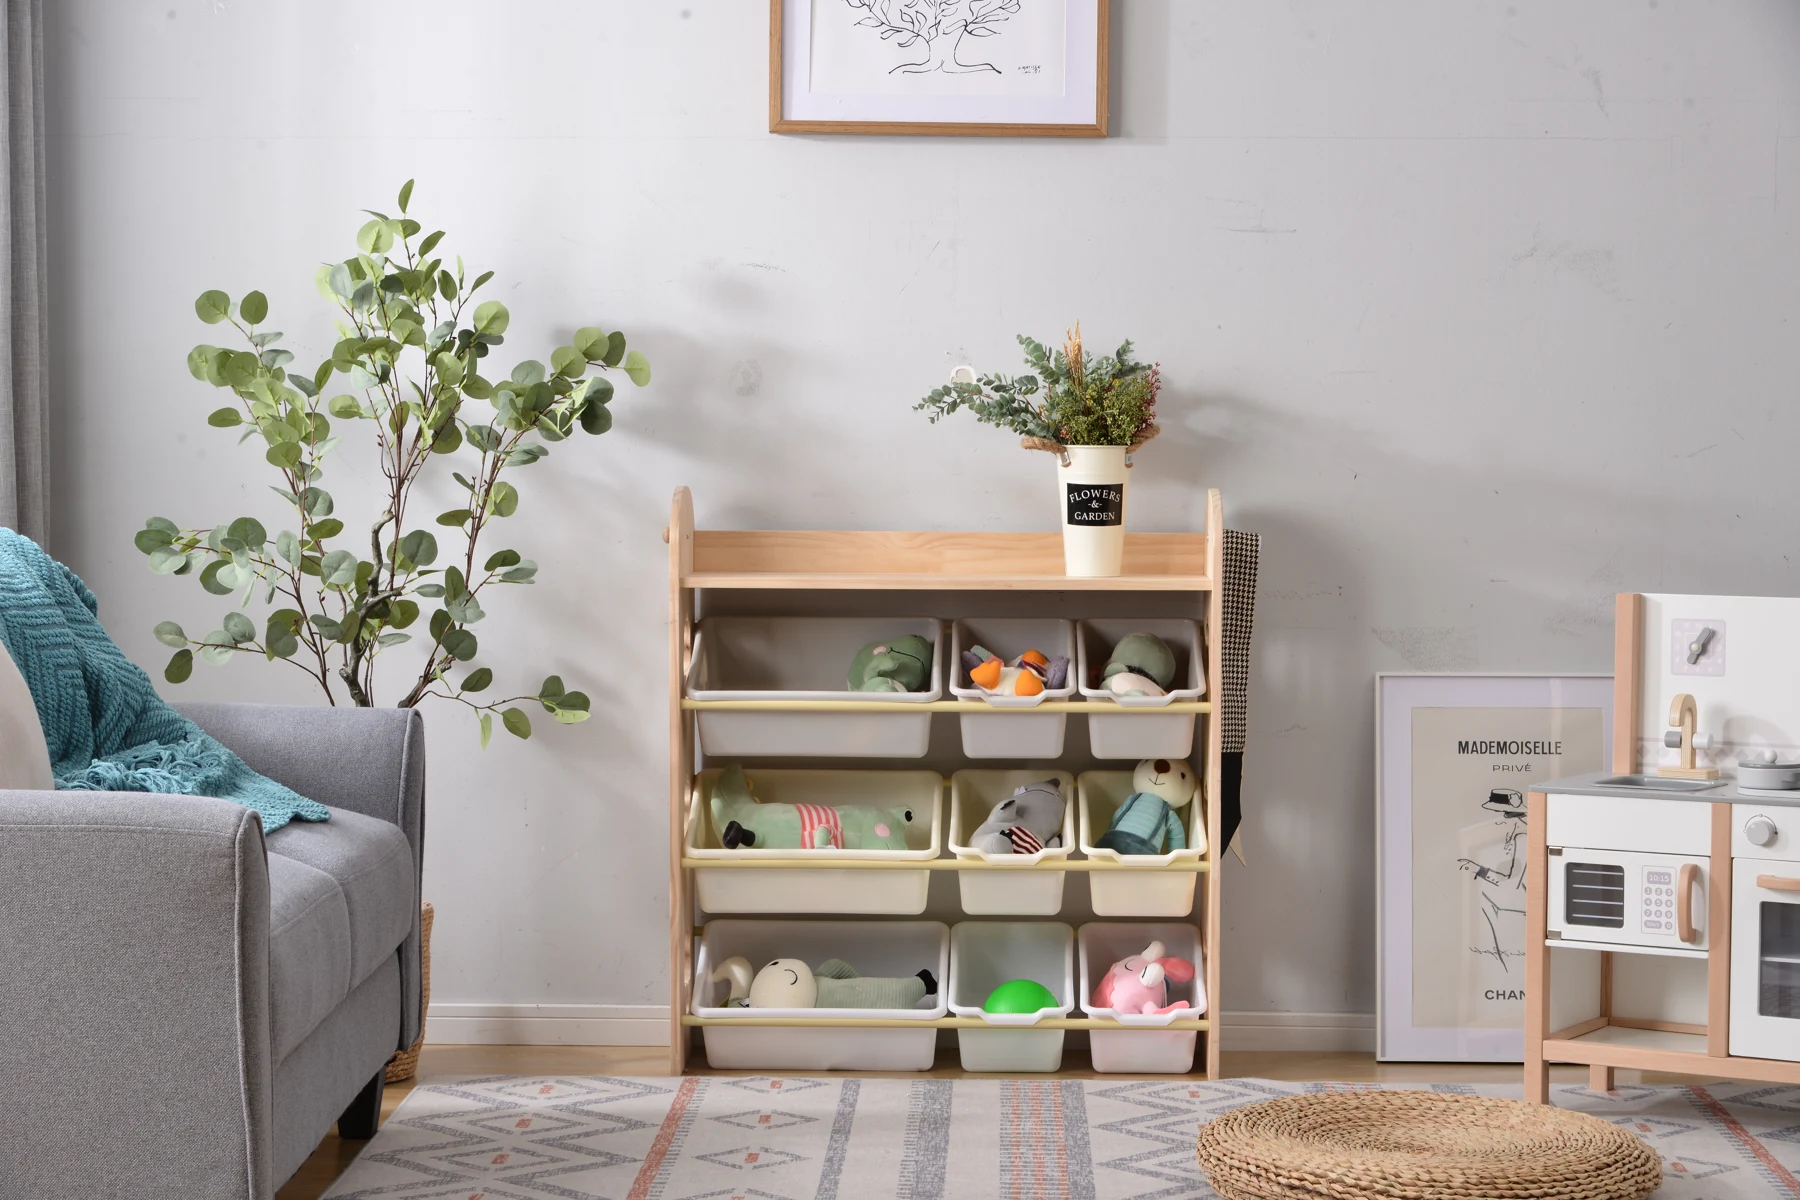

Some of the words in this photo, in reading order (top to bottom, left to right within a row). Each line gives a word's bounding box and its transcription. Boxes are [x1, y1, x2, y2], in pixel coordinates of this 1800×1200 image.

[1069, 489, 1121, 503] FLOWERS
[1074, 511, 1115, 520] GARDEN
[1458, 740, 1562, 755] MADEMOISELLE
[1492, 762, 1532, 772] PRIVÉ
